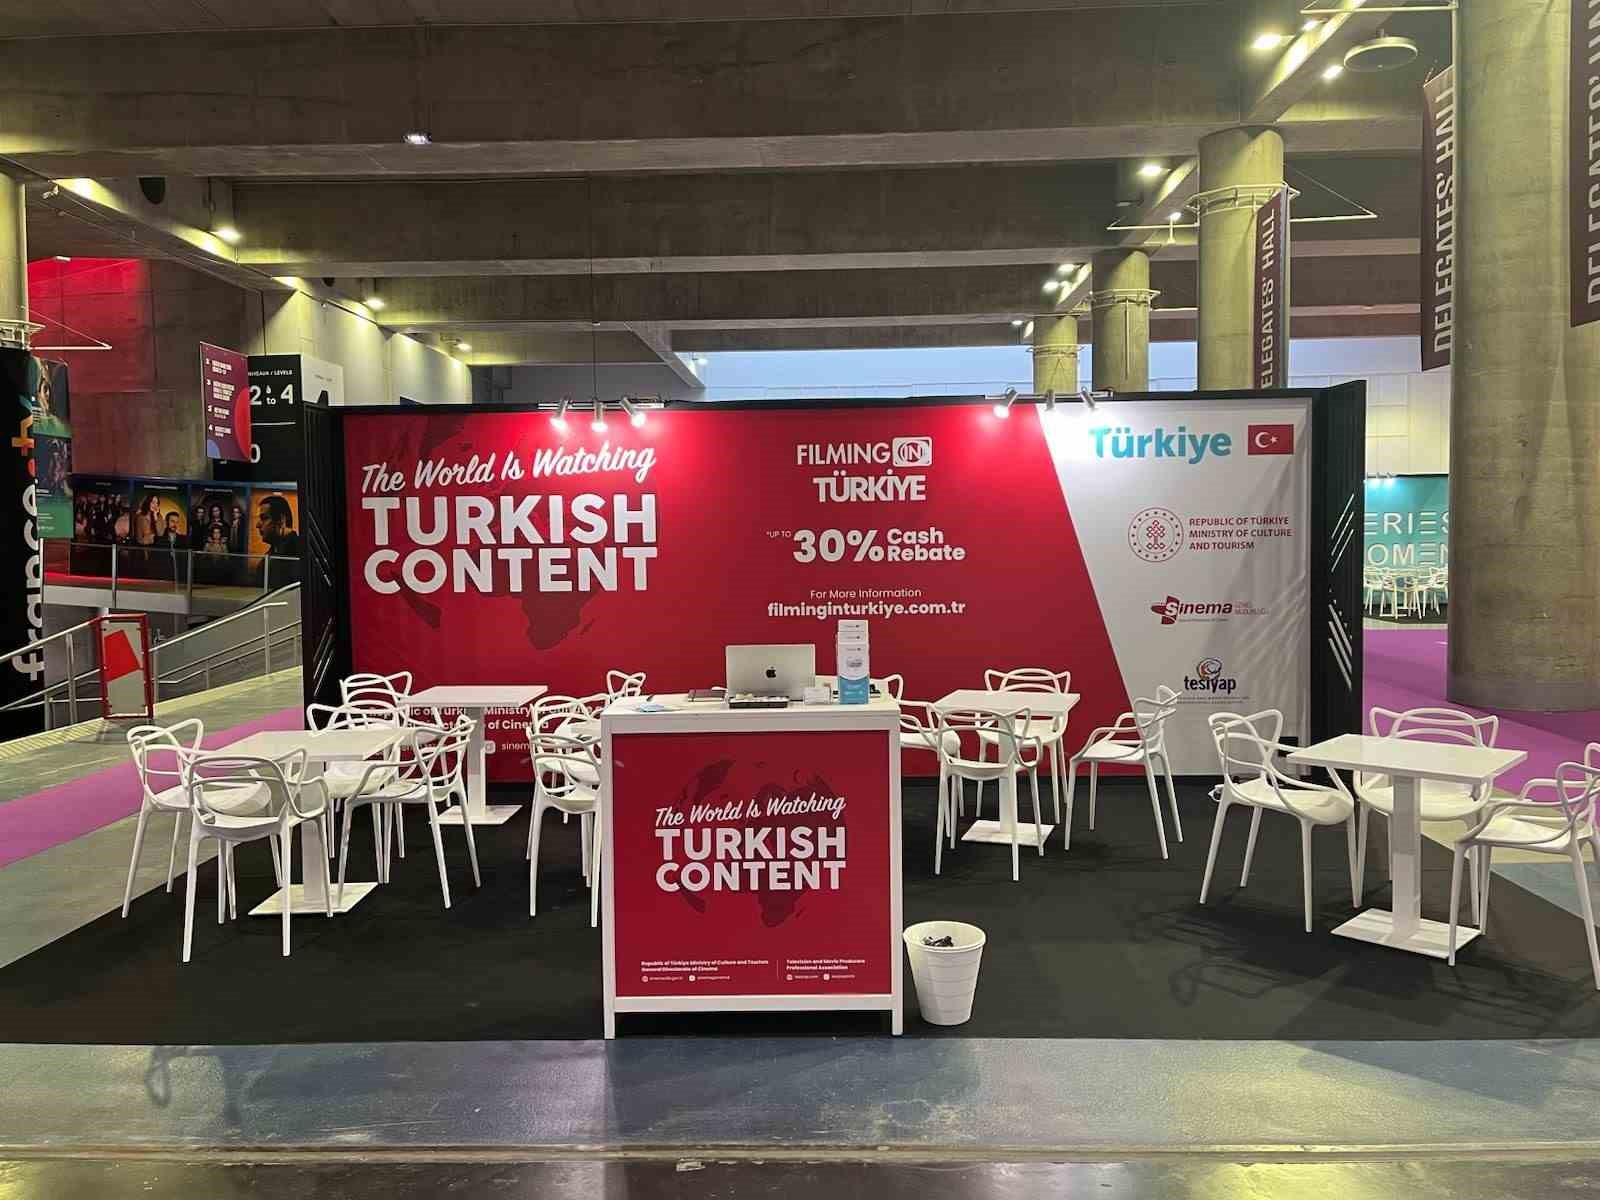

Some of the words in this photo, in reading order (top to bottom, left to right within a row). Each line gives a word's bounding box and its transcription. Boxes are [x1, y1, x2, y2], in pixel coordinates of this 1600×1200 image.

[1261, 209, 1275, 270] HALL
[1261, 277, 1274, 388] ELEGATES'
[250, 385, 261, 405] 2
[266, 397, 276, 405] to
[281, 384, 293, 404] 4
[797, 443, 890, 465] FILMING
[1089, 426, 1232, 464] Türkiye
[361, 463, 405, 493] The
[414, 453, 496, 488] World
[501, 451, 524, 480] Is
[533, 440, 656, 483] Watching
[812, 469, 927, 502] TÜRKİYE
[362, 494, 657, 546] TURKISH
[1189, 517, 1234, 527] REPUBLIC
[1236, 517, 1249, 526] OF
[1364, 511, 1448, 534] ERIE
[793, 529, 885, 563] 30%
[887, 527, 944, 545] Cash
[1189, 530, 1234, 539] MINISTRY
[1236, 529, 1249, 538] OF
[1250, 528, 1293, 537] CULTURE
[887, 545, 966, 562] Rebate
[1189, 542, 1211, 550] AND
[1213, 541, 1255, 550] TOURISM
[1367, 543, 1448, 566] OMEN
[364, 547, 658, 594] CONTENT
[810, 590, 828, 599] For
[829, 589, 856, 599] More
[859, 588, 922, 598] Information
[768, 601, 965, 619] filminginturkiye.com.tr
[1165, 602, 1233, 616] Sinema
[485, 705, 530, 717] Ministry
[488, 718, 499, 730] of
[502, 718, 549, 730] Cinea
[655, 806, 684, 827] The
[690, 799, 744, 824] World
[746, 799, 761, 819] Is
[767, 792, 846, 819] Watching
[655, 826, 846, 861] TURKISH
[655, 860, 847, 892] CONTENT
